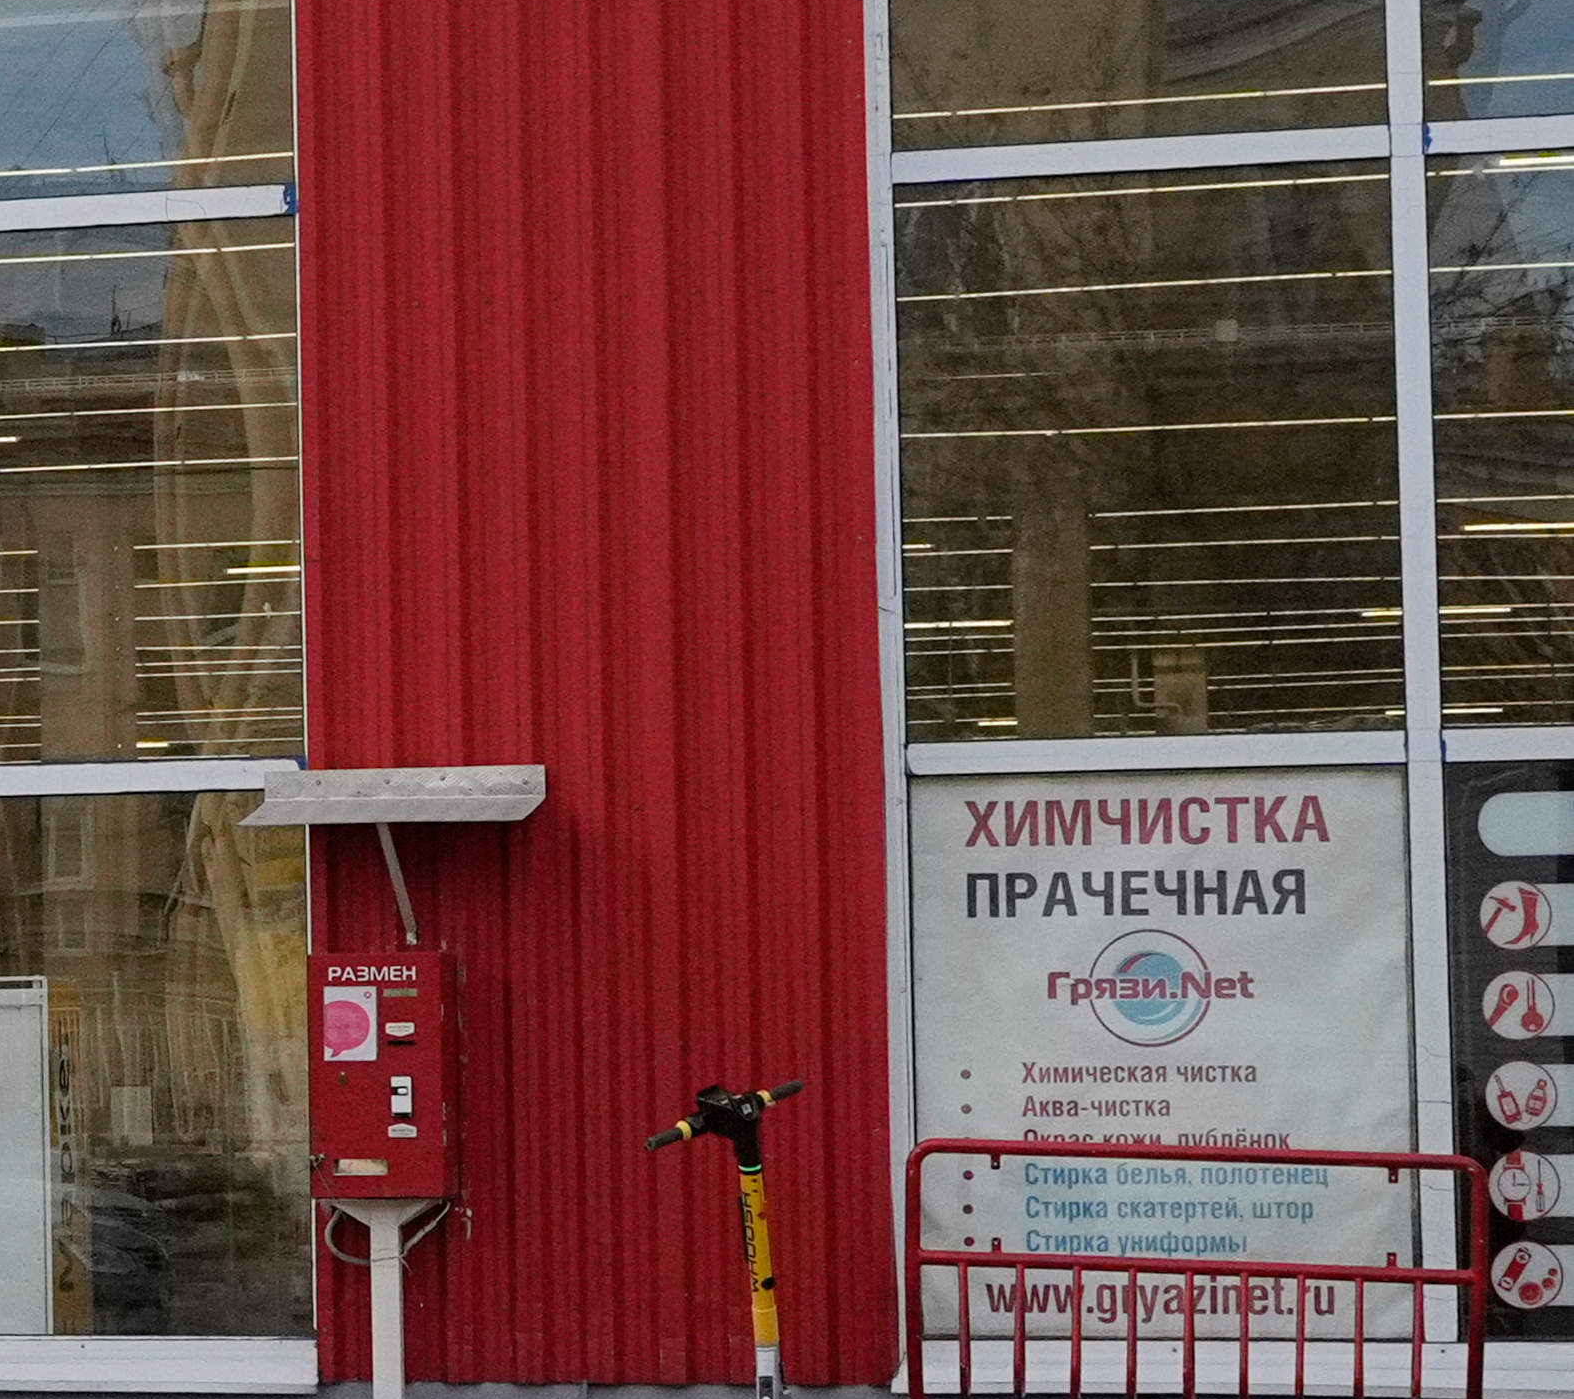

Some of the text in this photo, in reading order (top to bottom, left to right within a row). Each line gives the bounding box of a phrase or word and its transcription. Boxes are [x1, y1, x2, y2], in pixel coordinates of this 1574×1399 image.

[965, 794, 1331, 847] ХИМЧИСТКА
[966, 868, 1306, 918] ПРАЧЕЧНАЯ
[327, 965, 417, 982] РАЗМЕН
[1046, 970, 1256, 1004] Грязи.Net
[1021, 1061, 1258, 1085] Химическая чистка
[1021, 1095, 1171, 1119] Аква-чистка
[1025, 1162, 1108, 1188] Стирка
[1201, 1168, 1329, 1188] полотенец
[1026, 1196, 1315, 1223] Стирка скатертей, штор
[1026, 1230, 1248, 1257] Стирка униформы
[985, 1275, 1336, 1324] www.gyazinet.u
